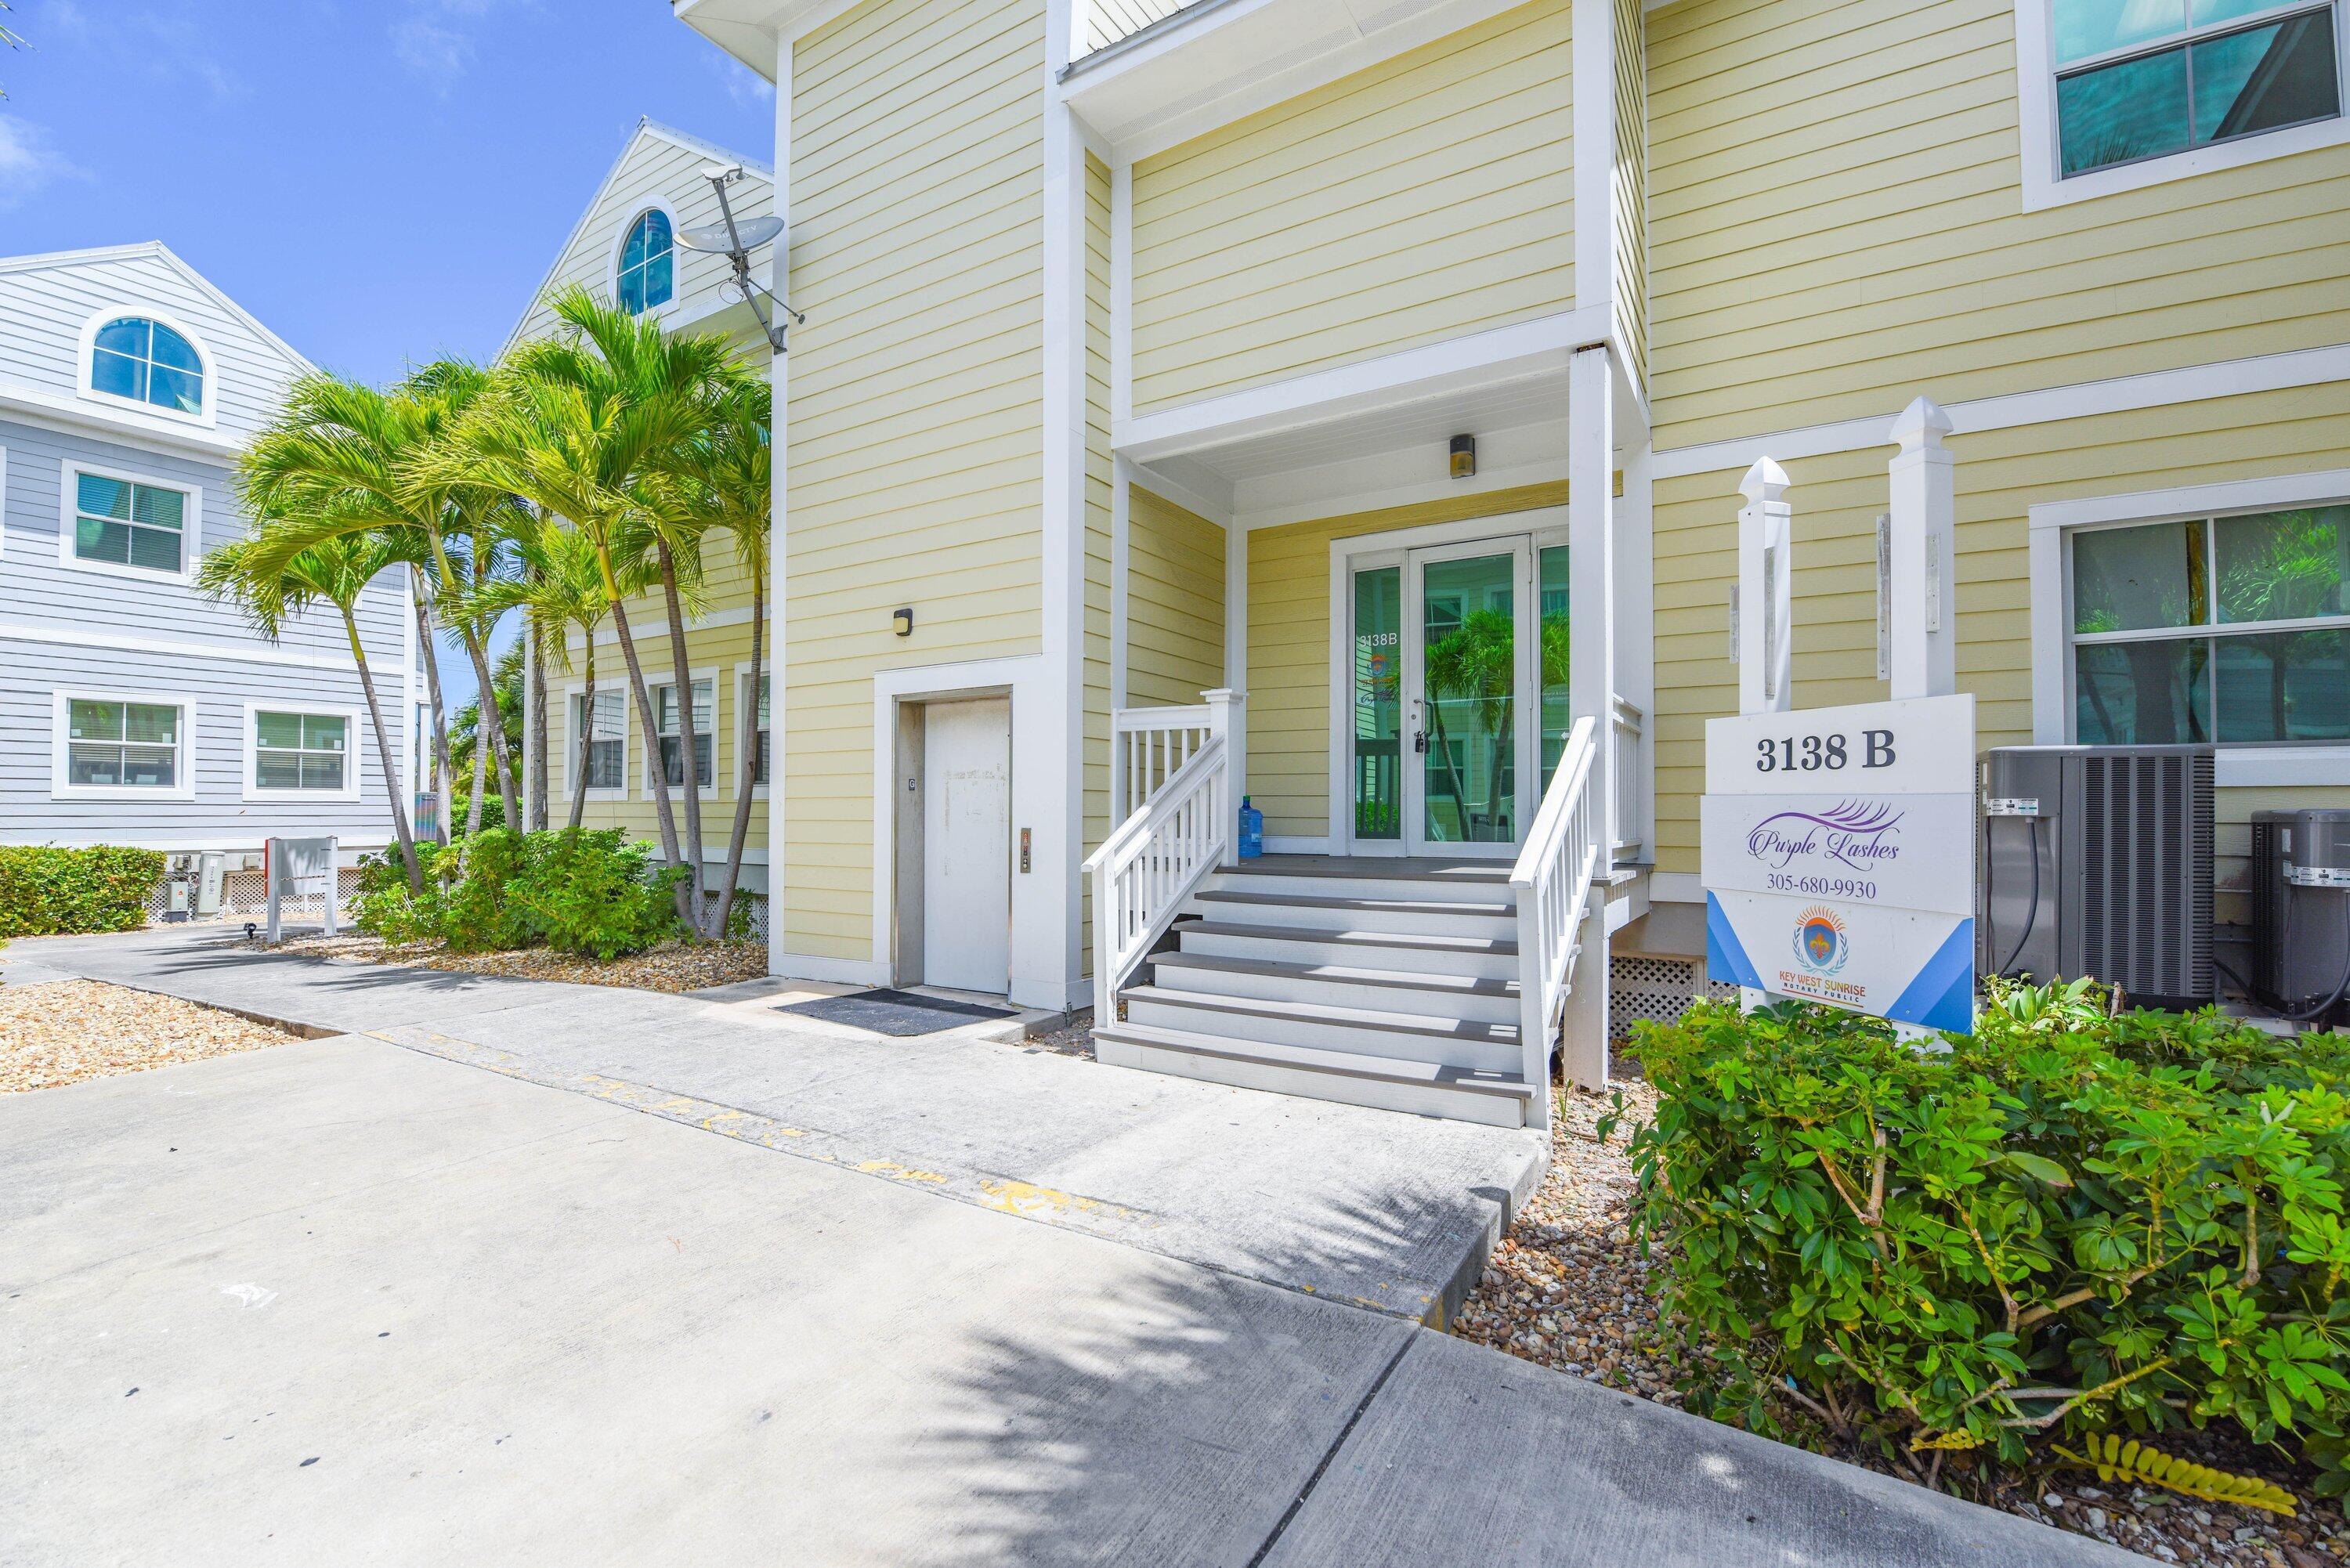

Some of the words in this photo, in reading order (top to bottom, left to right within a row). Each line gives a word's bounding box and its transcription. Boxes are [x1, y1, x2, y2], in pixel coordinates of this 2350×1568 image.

[714, 226, 757, 239] DIRCTV
[1360, 633, 1397, 648] 3138B
[1757, 734, 1847, 771] 3138
[1862, 730, 1896, 768] B
[909, 779, 915, 788] G
[1748, 826, 1829, 869] Purple
[1824, 827, 1900, 872] Lashes
[1767, 873, 1876, 899] 305-680-9930
[1779, 970, 1795, 984] KEY
[1798, 974, 1822, 988] WEST
[1824, 979, 1866, 997] SUNRISE
[1784, 982, 1817, 994] NOTARY
[1824, 991, 1860, 1003] PUBLIC
